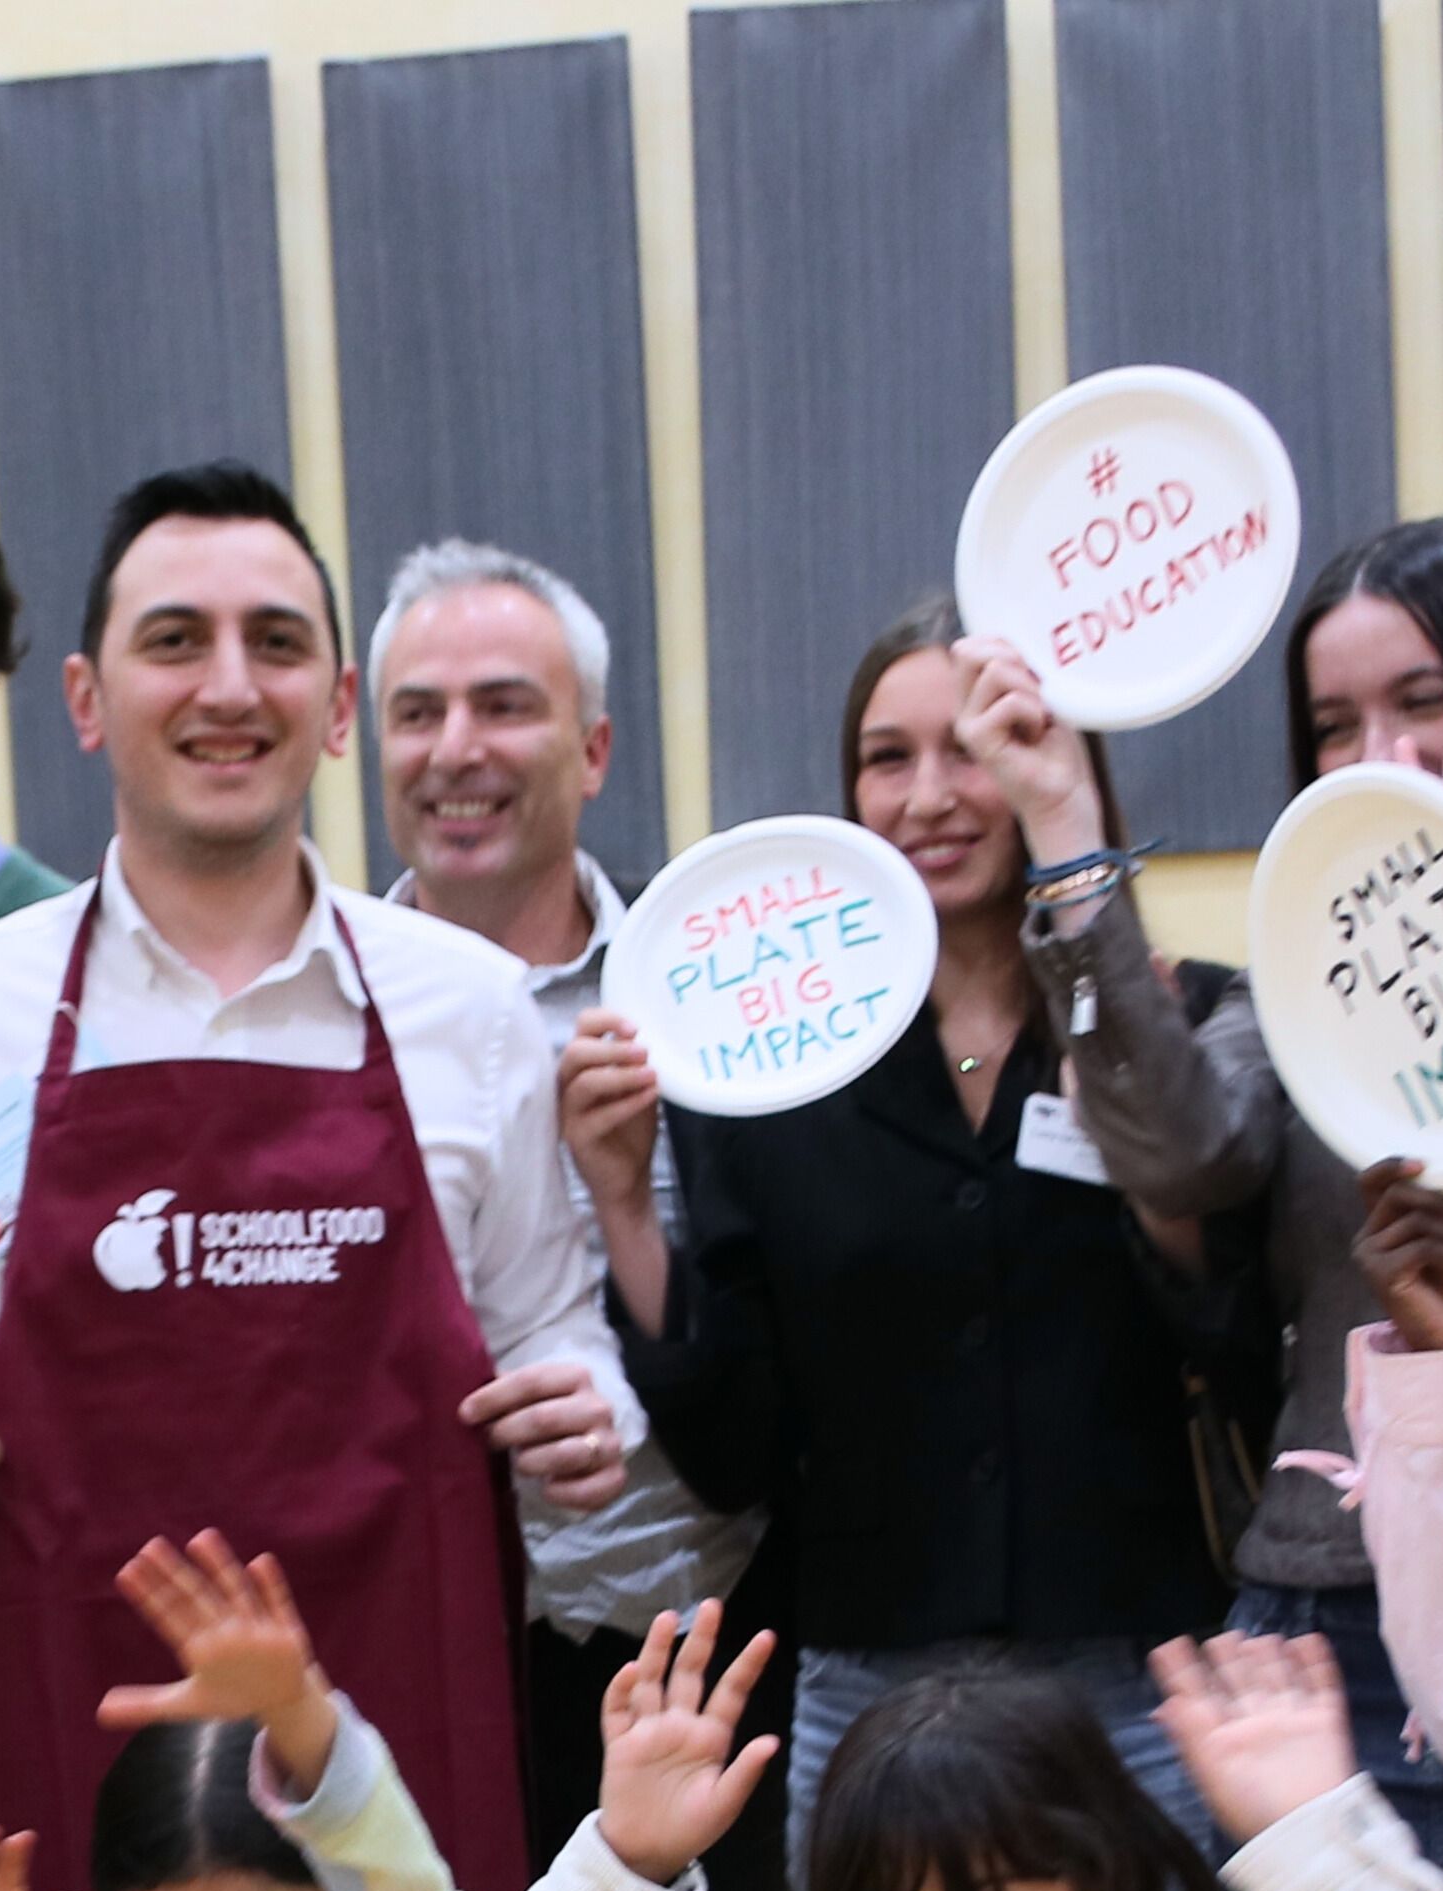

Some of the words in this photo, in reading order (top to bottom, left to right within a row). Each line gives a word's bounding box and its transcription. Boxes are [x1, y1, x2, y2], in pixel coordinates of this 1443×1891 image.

[1086, 447, 1121, 497] #
[1047, 479, 1194, 589] FOOD
[1051, 503, 1269, 667] EDUCATION
[666, 899, 883, 1005] PLATE
[684, 866, 843, 952] SMALL
[699, 987, 890, 1080] IMPACT
[737, 963, 833, 1026] BIG
[199, 1206, 386, 1249] SCHOOLFOOD
[201, 1246, 340, 1286] 4CHANGE
